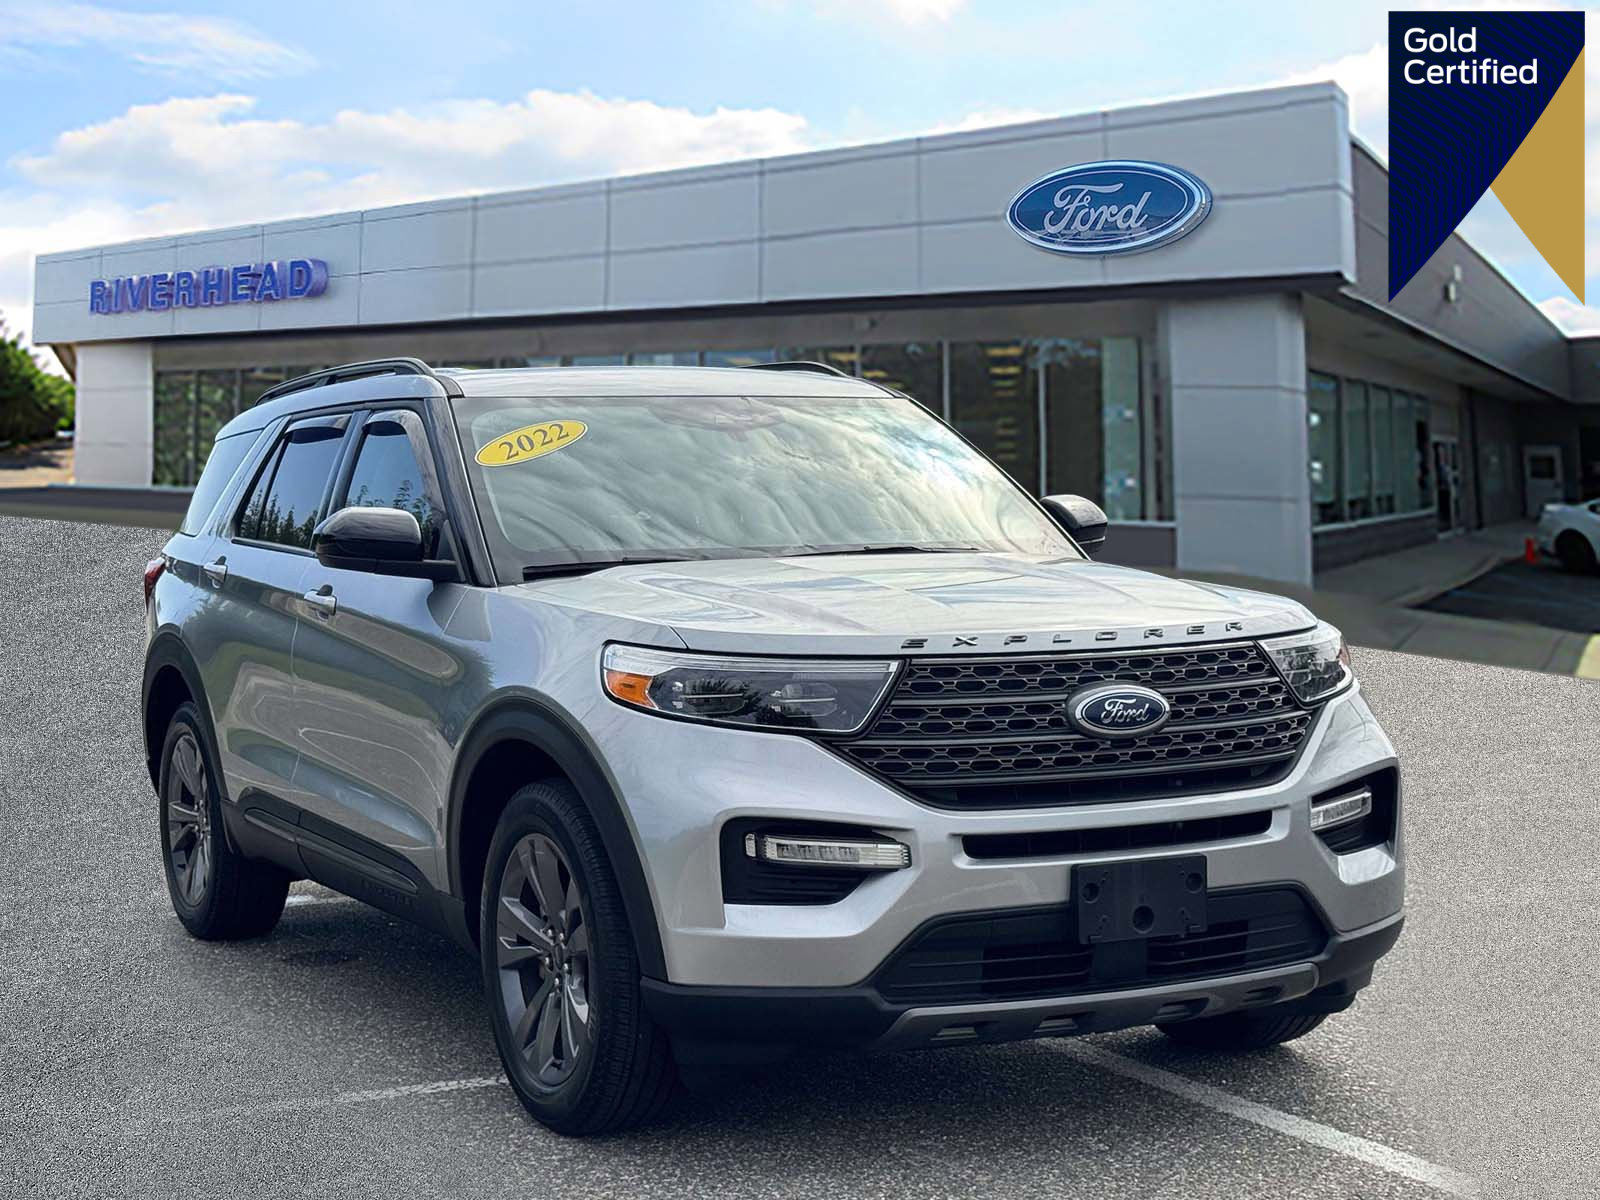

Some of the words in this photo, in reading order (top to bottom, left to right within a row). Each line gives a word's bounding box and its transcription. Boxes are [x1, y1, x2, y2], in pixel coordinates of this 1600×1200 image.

[1043, 182, 1152, 234] Ford
[89, 258, 323, 314] RIVERHEAD
[498, 423, 570, 460] 2022
[900, 621, 1243, 649] EXPLORER
[1100, 698, 1150, 724] Ford
